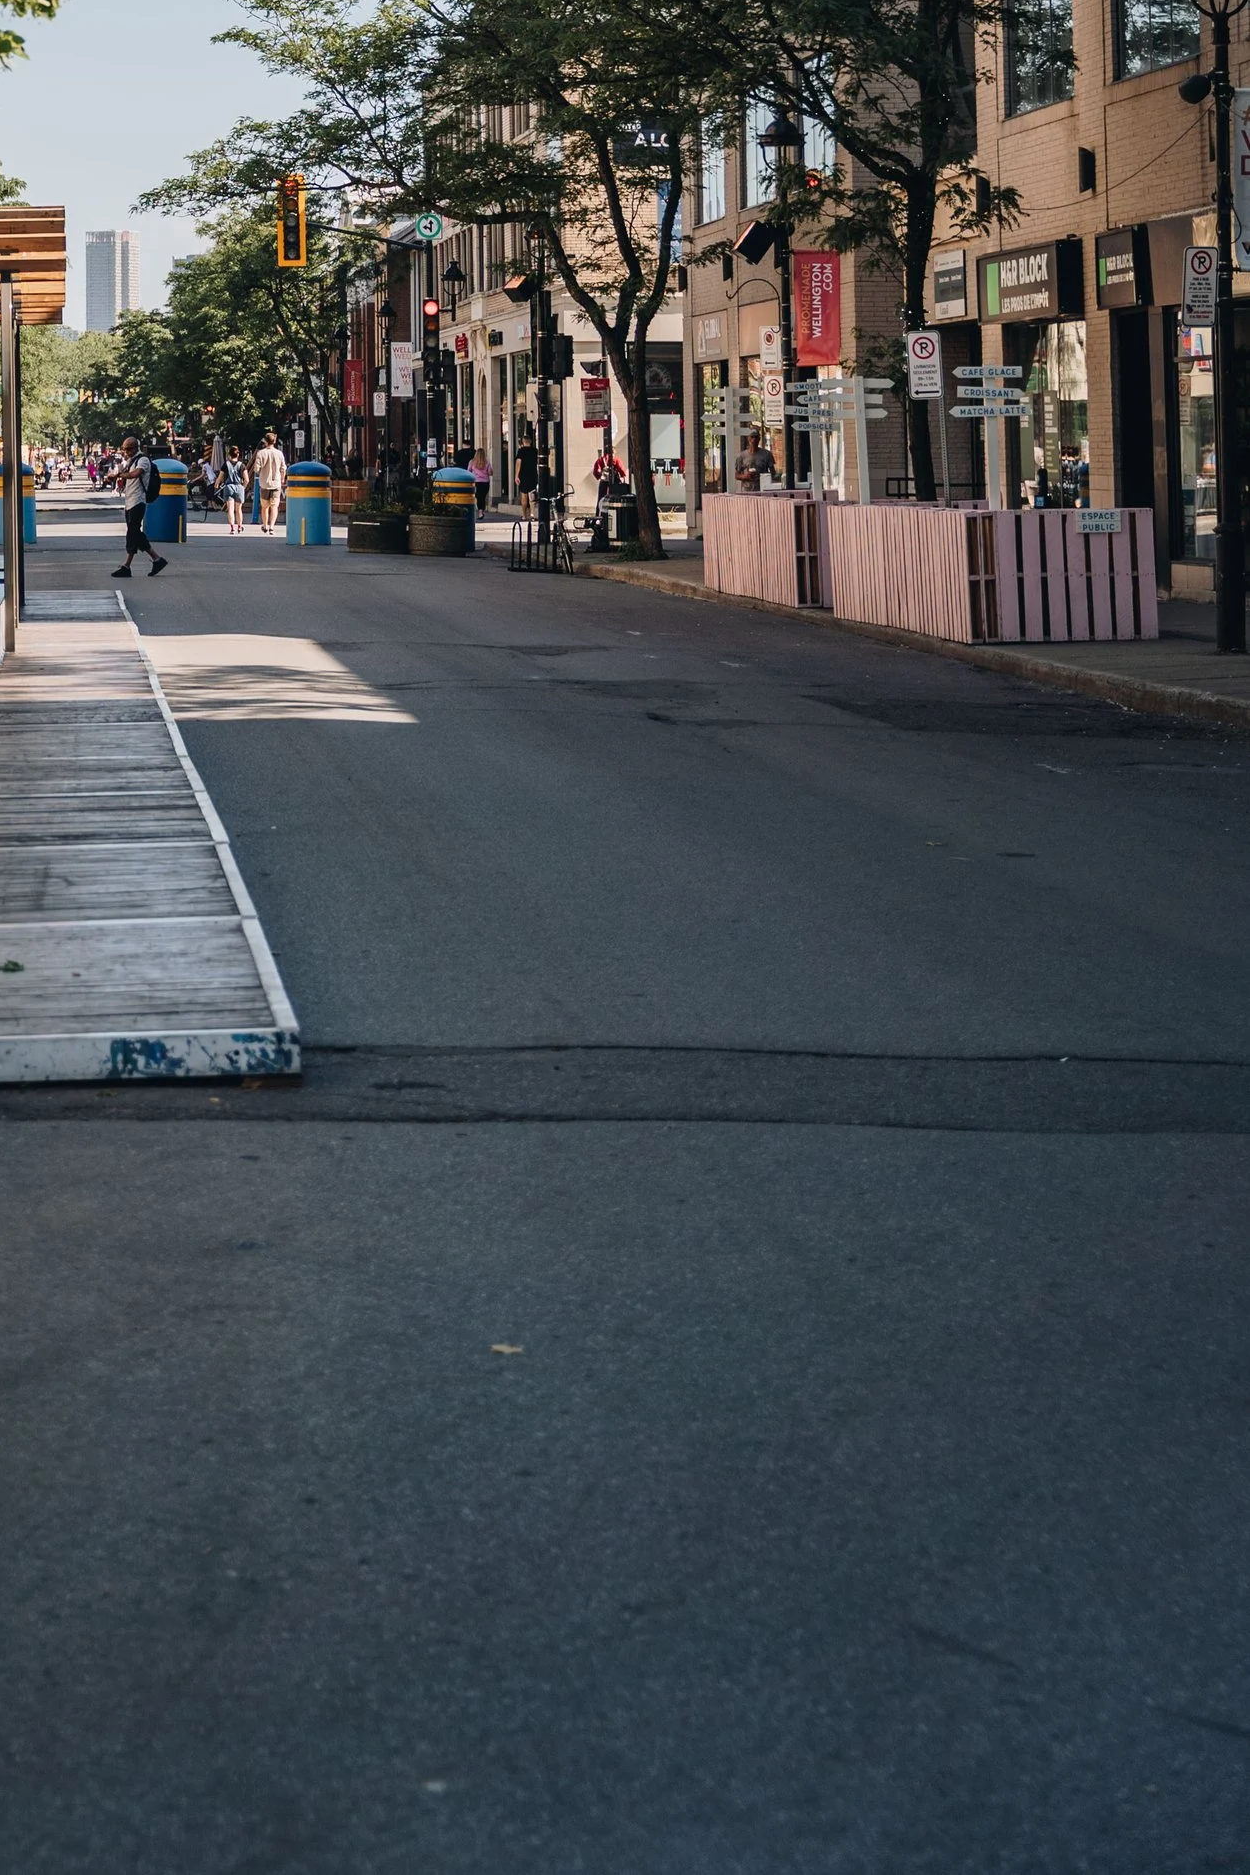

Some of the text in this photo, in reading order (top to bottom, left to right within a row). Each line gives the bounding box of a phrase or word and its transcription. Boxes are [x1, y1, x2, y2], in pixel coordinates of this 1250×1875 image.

[823, 263, 833, 293] .COM
[1000, 253, 1048, 287] H&R BLOCK
[801, 263, 810, 334] PROMENADE
[812, 263, 822, 338] WELLINGTON
[963, 388, 1015, 397] CROISSANT
[959, 406, 1026, 415] MATCHA LATTE
[1081, 512, 1115, 520] ESPACE
